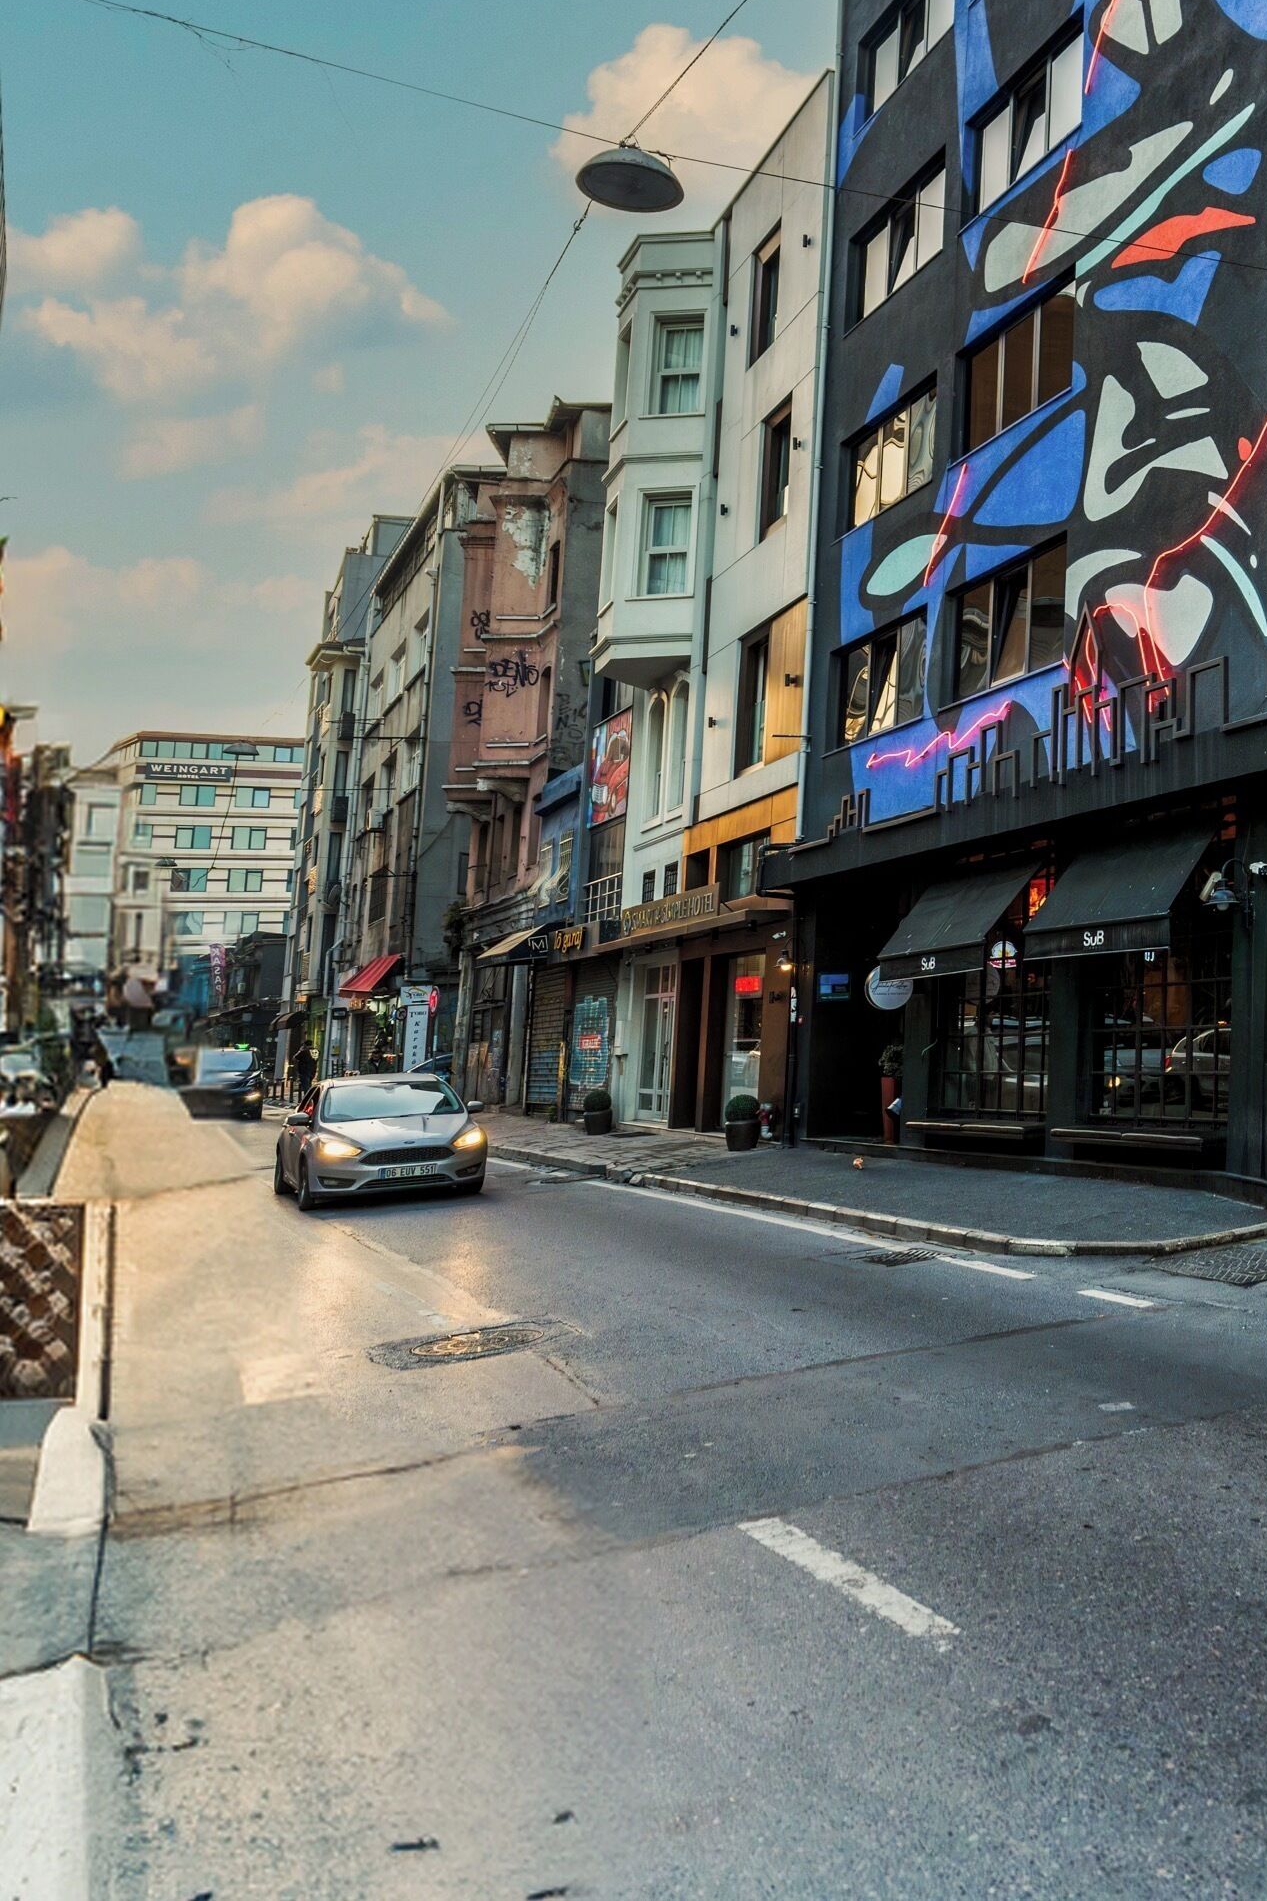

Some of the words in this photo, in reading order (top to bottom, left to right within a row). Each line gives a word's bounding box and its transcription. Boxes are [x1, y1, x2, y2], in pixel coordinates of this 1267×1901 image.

[150, 764, 228, 774] WEINGART
[687, 893, 714, 916] HOTEL
[1083, 930, 1104, 947] SuB
[921, 957, 935, 971] SuB
[386, 1169, 397, 1177] 06
[400, 1167, 416, 1176] EUV
[420, 1165, 434, 1174] 551
